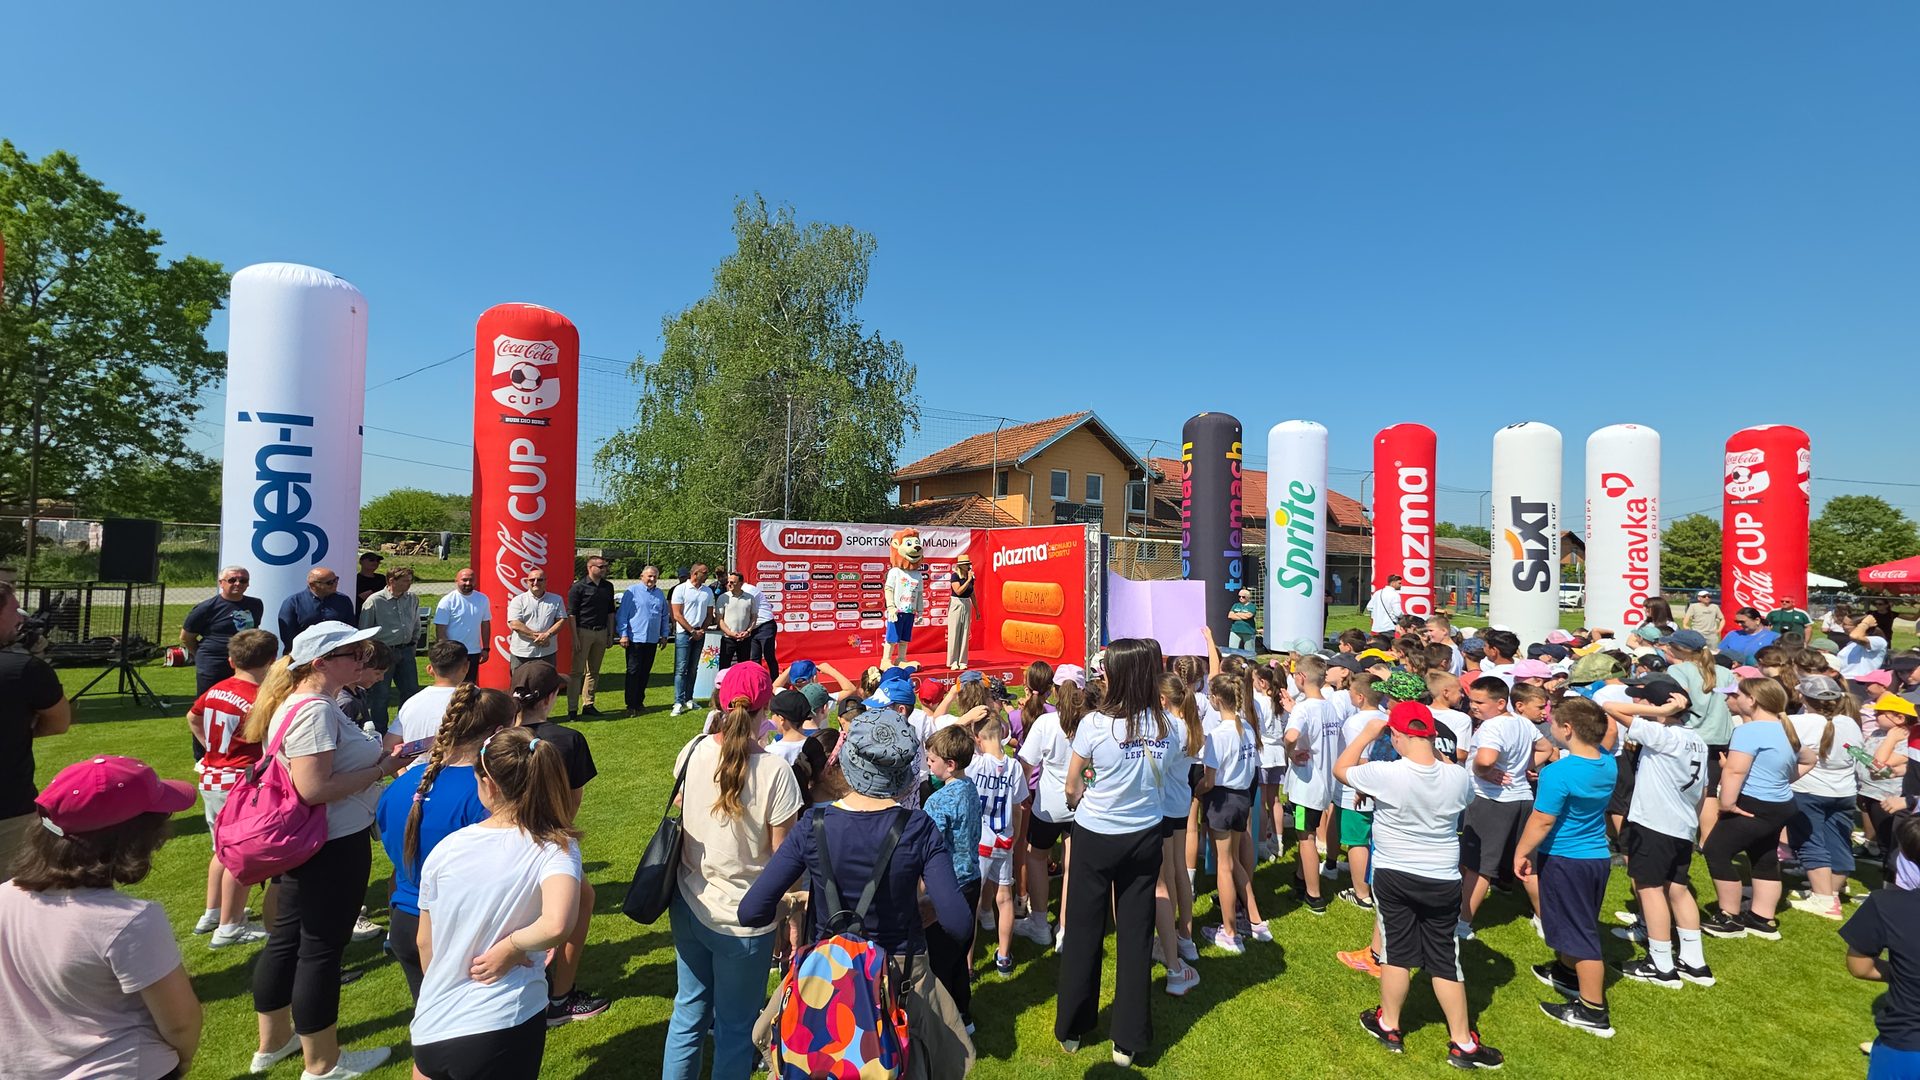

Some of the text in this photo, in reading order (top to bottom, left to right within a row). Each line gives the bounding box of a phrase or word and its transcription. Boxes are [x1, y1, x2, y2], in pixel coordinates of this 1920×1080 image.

[497, 339, 556, 362] Coca-Cola
[508, 395, 544, 406] CUP
[238, 411, 329, 566] gen-i
[507, 437, 548, 523] CUP
[1731, 485, 1755, 493] CUP
[1224, 441, 1242, 592] telemach
[784, 532, 958, 548] plazma SPORTSK MLADIH
[1276, 480, 1320, 598] Sprite
[1397, 466, 1431, 621] plazma
[1506, 496, 1551, 593] SIXT
[1734, 512, 1768, 566] CUP
[993, 543, 1048, 572] plazma
[1621, 497, 1650, 626] Podravka
[1869, 569, 1909, 579] Coca-Cola
[1014, 590, 1046, 604] PLAZMA
[1015, 630, 1046, 645] PLAZMA
[203, 707, 241, 754] 17
[1125, 750, 1163, 760] LEKIK
[1680, 760, 1701, 792] 7
